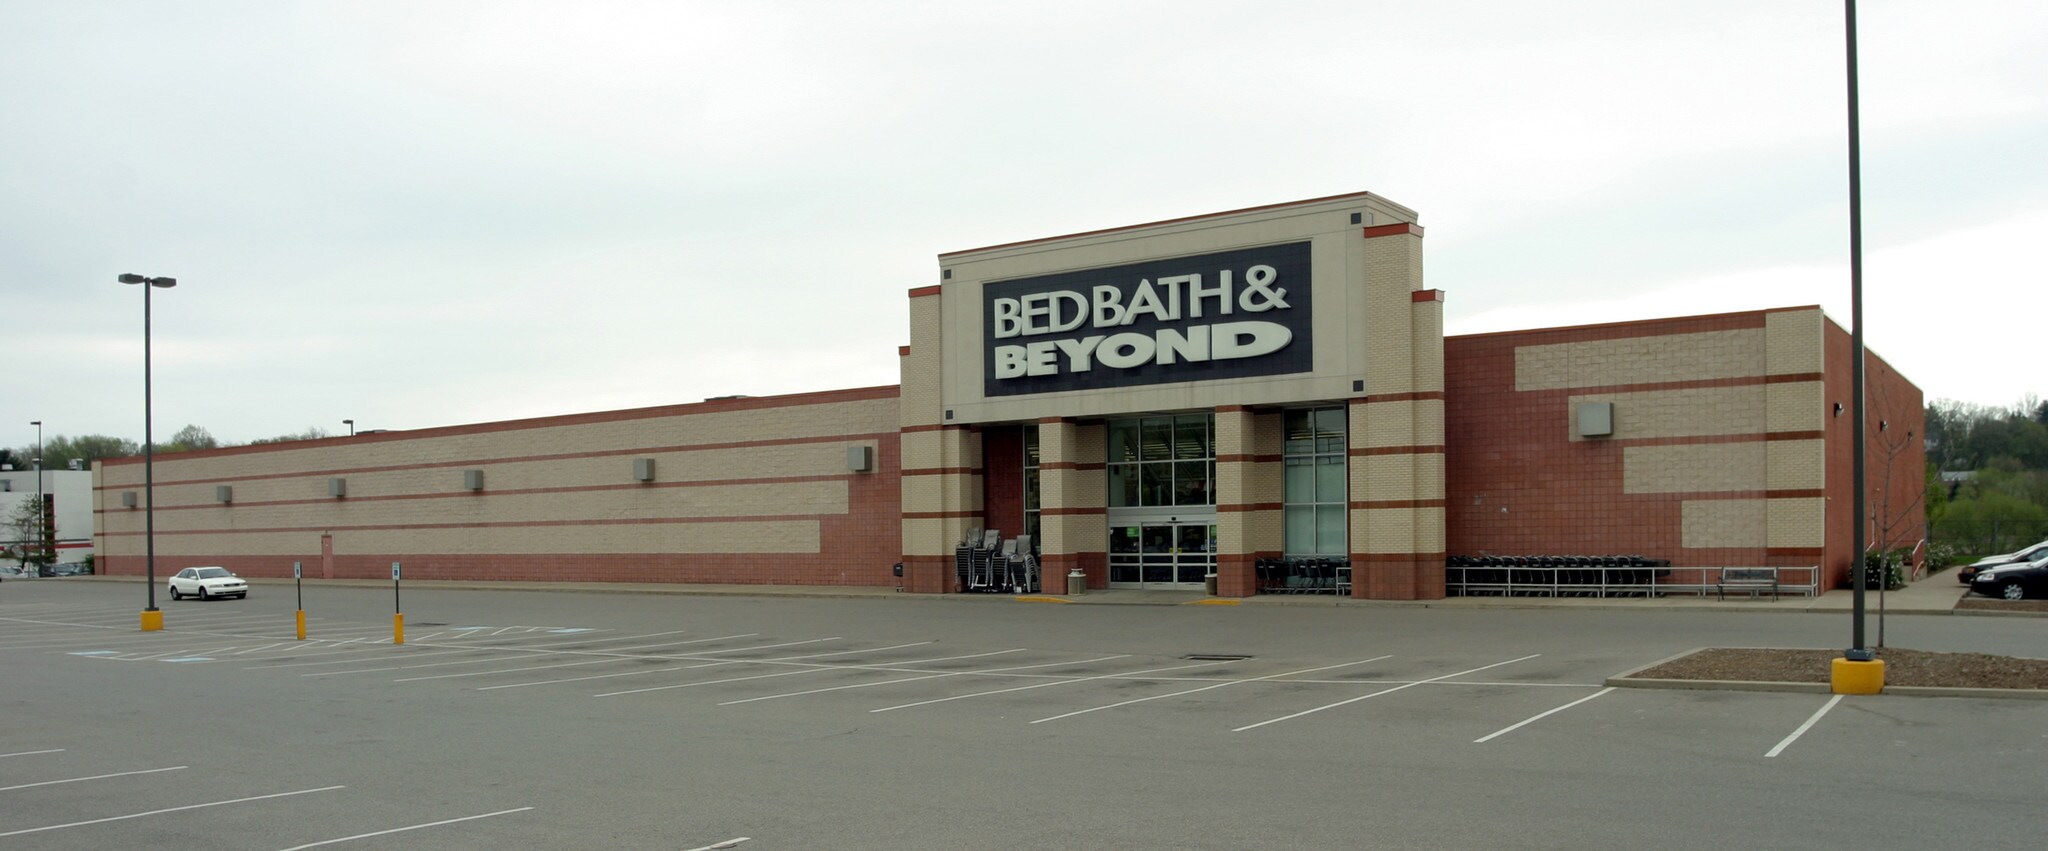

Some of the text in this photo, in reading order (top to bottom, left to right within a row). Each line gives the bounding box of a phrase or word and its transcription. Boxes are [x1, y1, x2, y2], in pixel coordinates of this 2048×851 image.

[994, 264, 1291, 338] BED BATH &
[994, 321, 1292, 379] BEYOND
